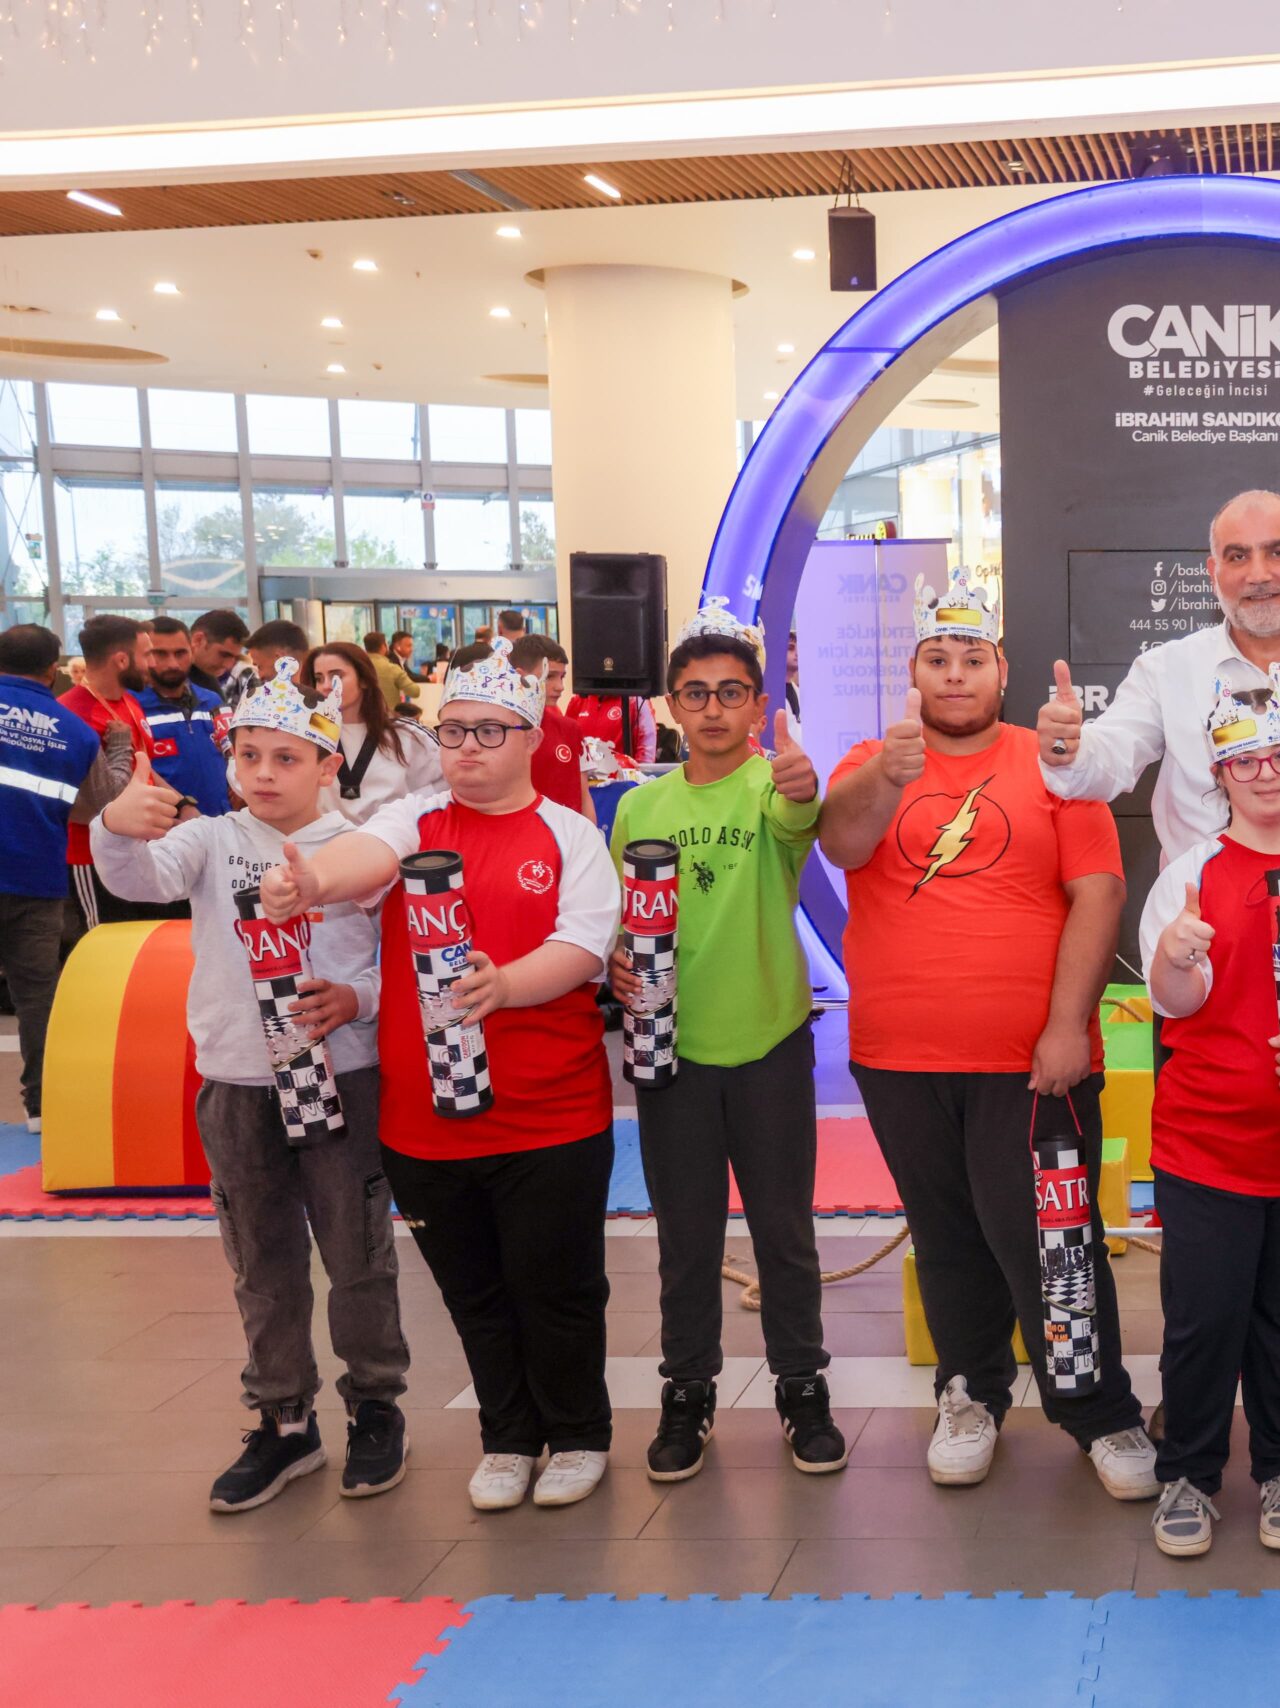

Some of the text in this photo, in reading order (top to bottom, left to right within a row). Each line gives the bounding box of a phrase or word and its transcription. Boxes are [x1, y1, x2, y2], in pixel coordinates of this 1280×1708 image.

[1131, 430, 1279, 444] Canik Belediye Başkanı
[1129, 619, 1151, 631] 444
[1154, 618, 1169, 631] 55
[1172, 618, 1187, 631] 90
